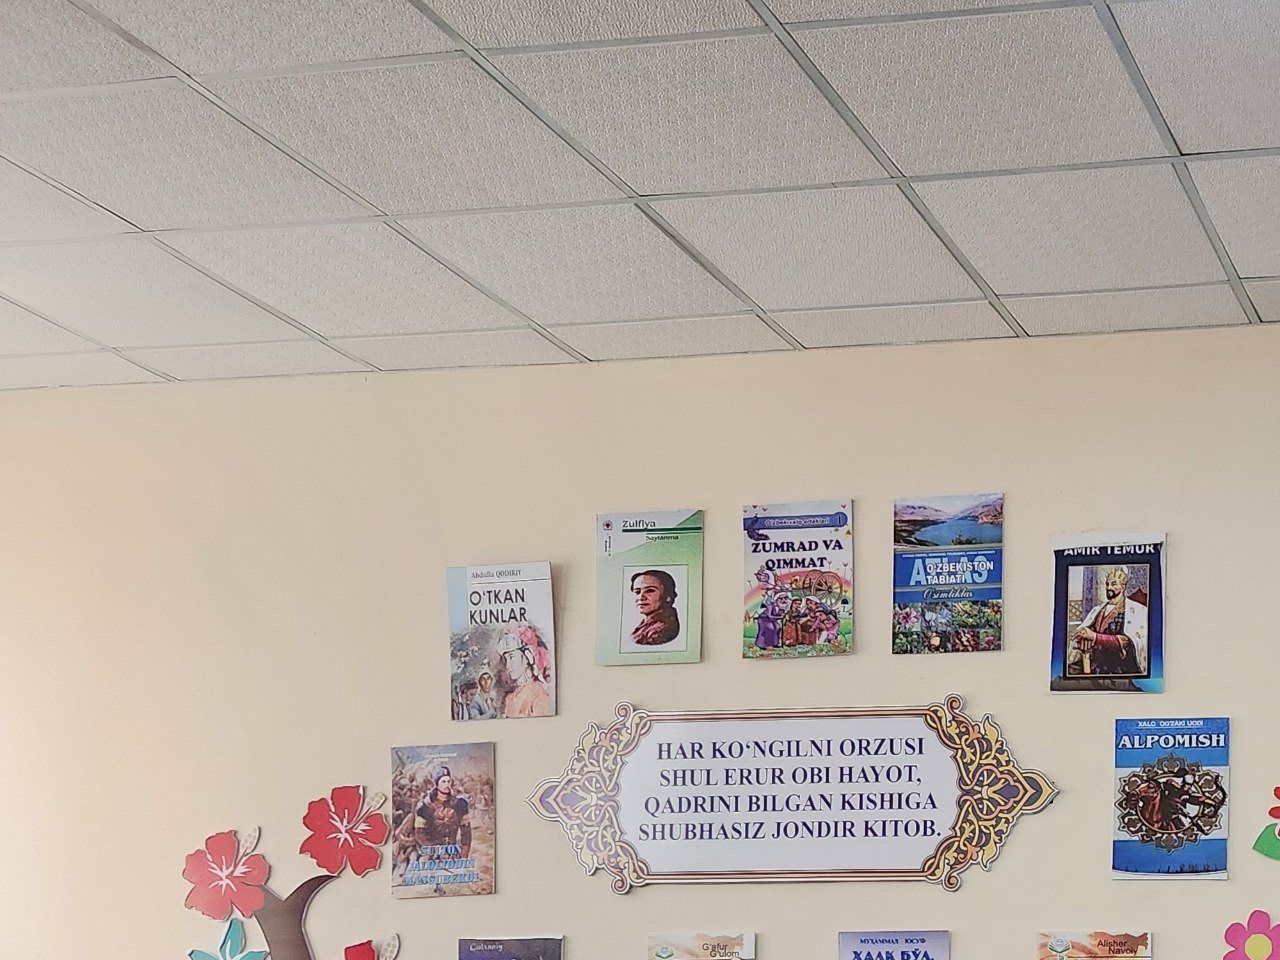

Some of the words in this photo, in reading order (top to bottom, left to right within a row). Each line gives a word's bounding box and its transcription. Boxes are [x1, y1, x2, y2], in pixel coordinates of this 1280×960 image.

[751, 540, 819, 554] ZUMRAD
[822, 539, 844, 551] VA
[765, 556, 828, 572] QIMMAT
[926, 560, 994, 573] O'ZBEKISTON
[926, 574, 965, 585] TABIATI
[469, 607, 528, 625] KUNLAR
[656, 741, 705, 760] HAR
[711, 738, 832, 760] KO‘NGILNI
[839, 737, 926, 757] ORZUSI
[1118, 734, 1225, 749] ALPOMISH
[659, 768, 719, 787] SHUL
[724, 766, 785, 786] ERUR
[791, 765, 831, 785] OBI
[838, 764, 923, 786] HAYOT,
[644, 795, 740, 818] QADRINI
[746, 793, 833, 813] BILGAN
[839, 791, 938, 812] KISHIGA
[638, 821, 767, 842] SHUBHASIZ
[771, 819, 855, 840] JONDIR
[862, 818, 942, 839] KITOB.
[1096, 940, 1128, 948] Alisher
[1108, 947, 1138, 956] Navoiy
